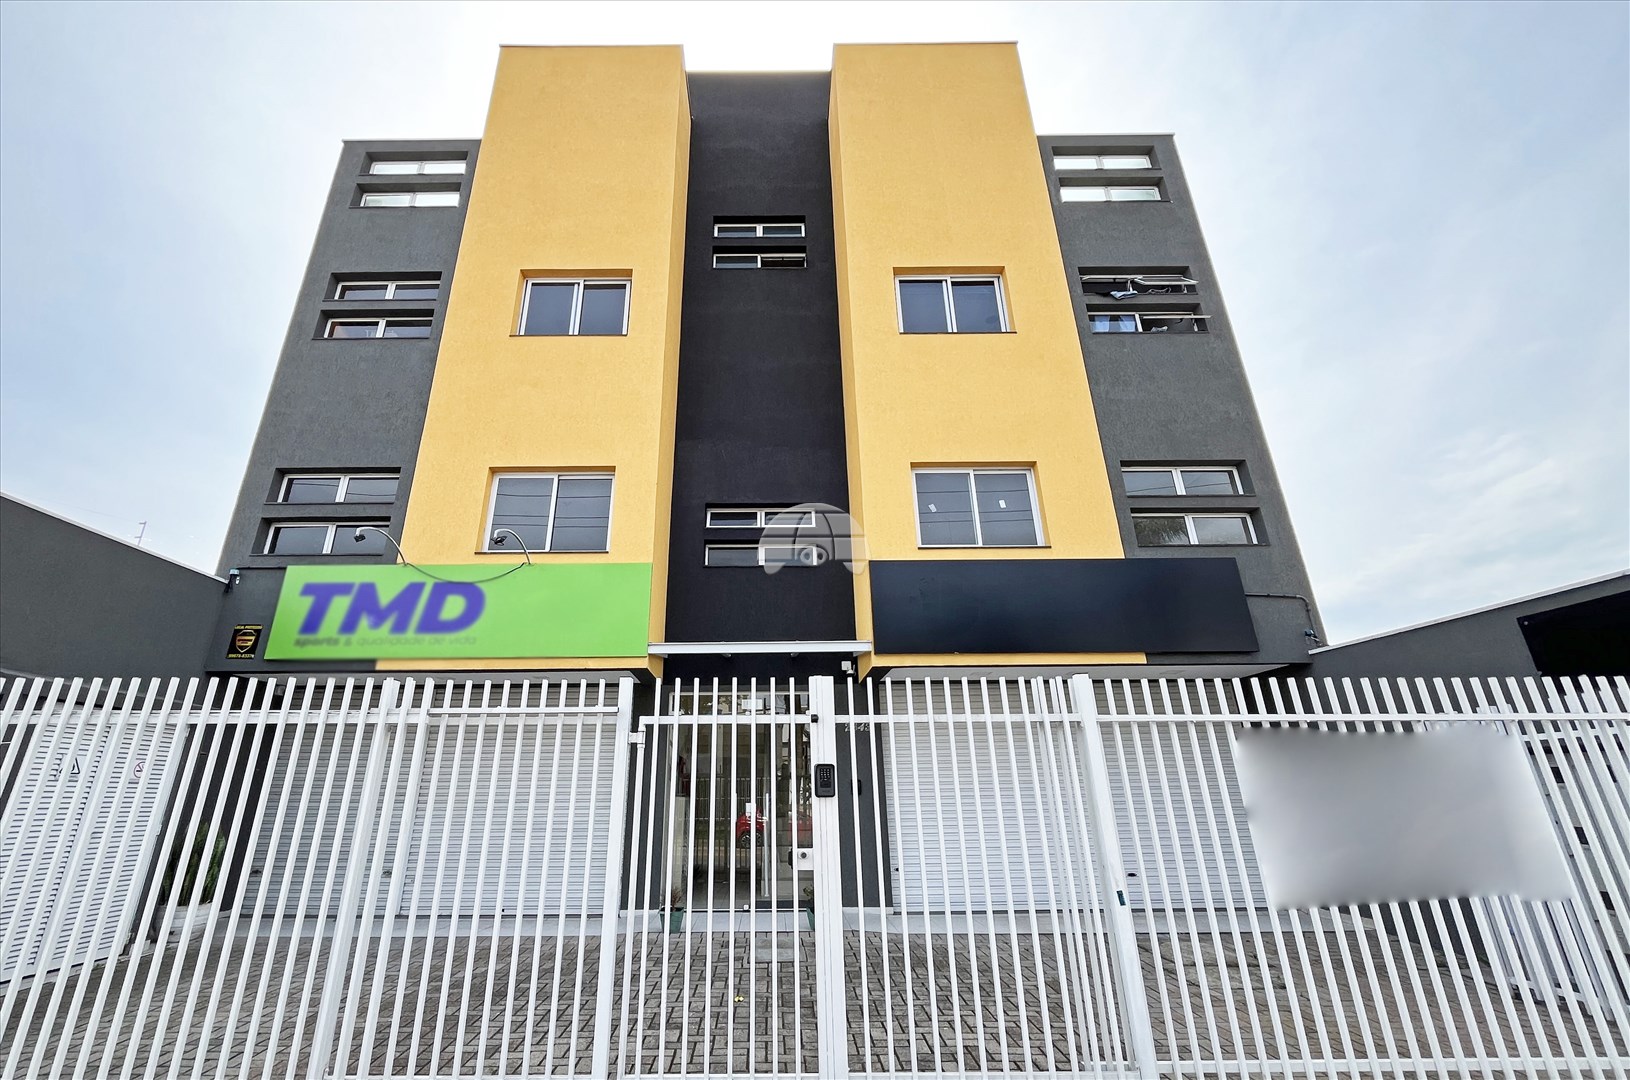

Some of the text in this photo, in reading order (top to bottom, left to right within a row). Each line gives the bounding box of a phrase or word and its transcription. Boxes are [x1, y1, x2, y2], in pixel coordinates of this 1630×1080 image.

[298, 581, 486, 635] TMD
[294, 636, 340, 648] sports
[357, 636, 425, 648] qualidade
[428, 635, 447, 646] de
[450, 635, 477, 646] vida
